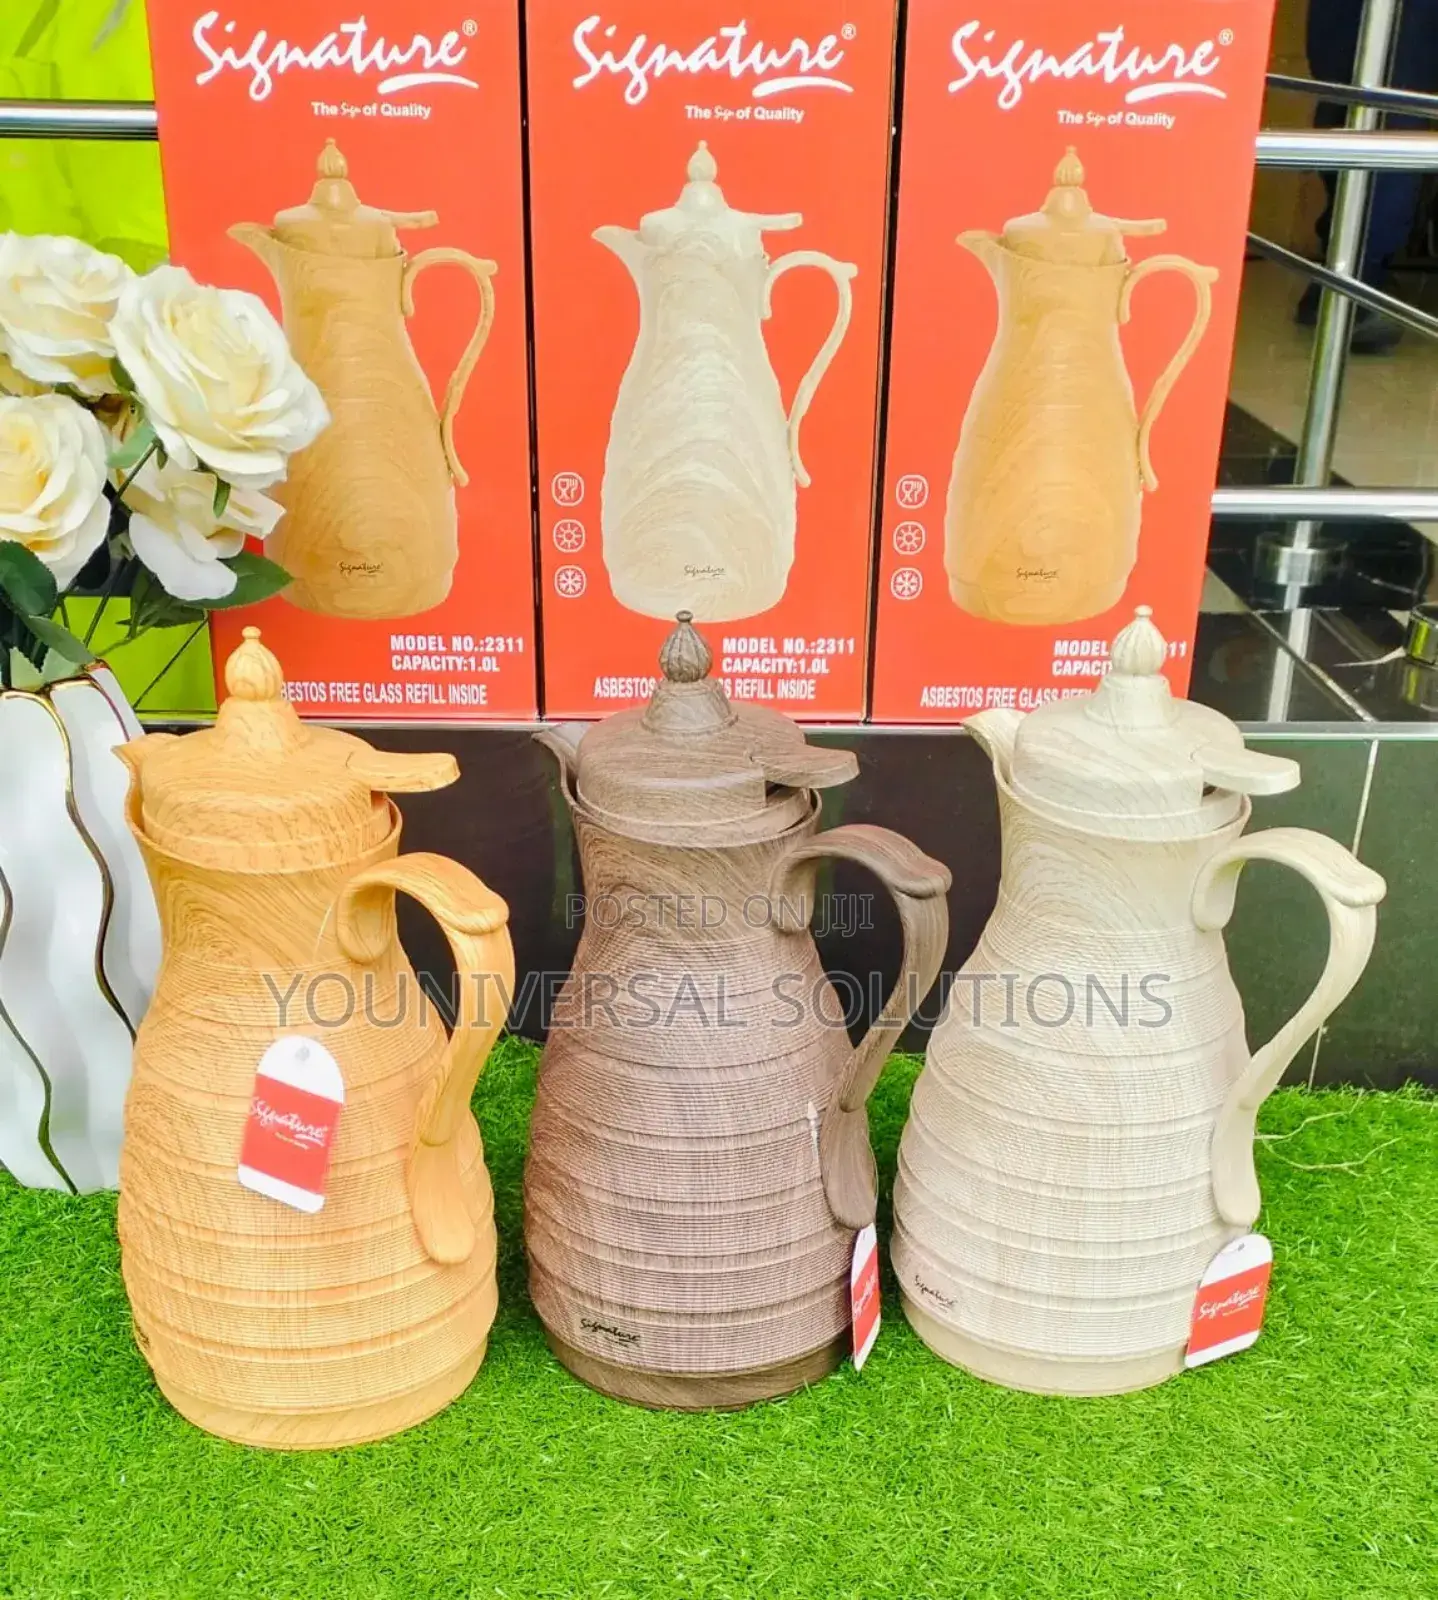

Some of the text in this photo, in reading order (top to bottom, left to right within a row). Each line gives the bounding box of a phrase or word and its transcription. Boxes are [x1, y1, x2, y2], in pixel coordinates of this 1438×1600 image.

[192, 10, 467, 101] Signature
[573, 14, 844, 105] Signature
[947, 19, 1220, 110] Signature
[311, 101, 338, 116] The
[362, 103, 377, 117] of
[380, 103, 432, 120] Quality
[685, 105, 711, 119] The
[736, 106, 751, 120] of
[754, 106, 804, 124] Quality
[1057, 110, 1083, 124] The
[1107, 112, 1123, 125] of
[1125, 112, 1175, 130] Quality
[390, 635, 524, 652] MODEL NO.:2311
[722, 638, 855, 654] MODEL NO.:2311
[1053, 640, 1109, 656] MODEL
[391, 656, 500, 672] CAPACITY:1.0L
[722, 657, 829, 674] CAPACITY:1.0L
[281, 681, 488, 705] BESTOS FREE GLASS REFILL INSIDE
[594, 677, 656, 699] ASBESTOS
[735, 679, 774, 700] REFILL
[777, 679, 816, 701] INSIDE
[920, 686, 983, 708] ASBESTOS
[985, 687, 1017, 708] FREE
